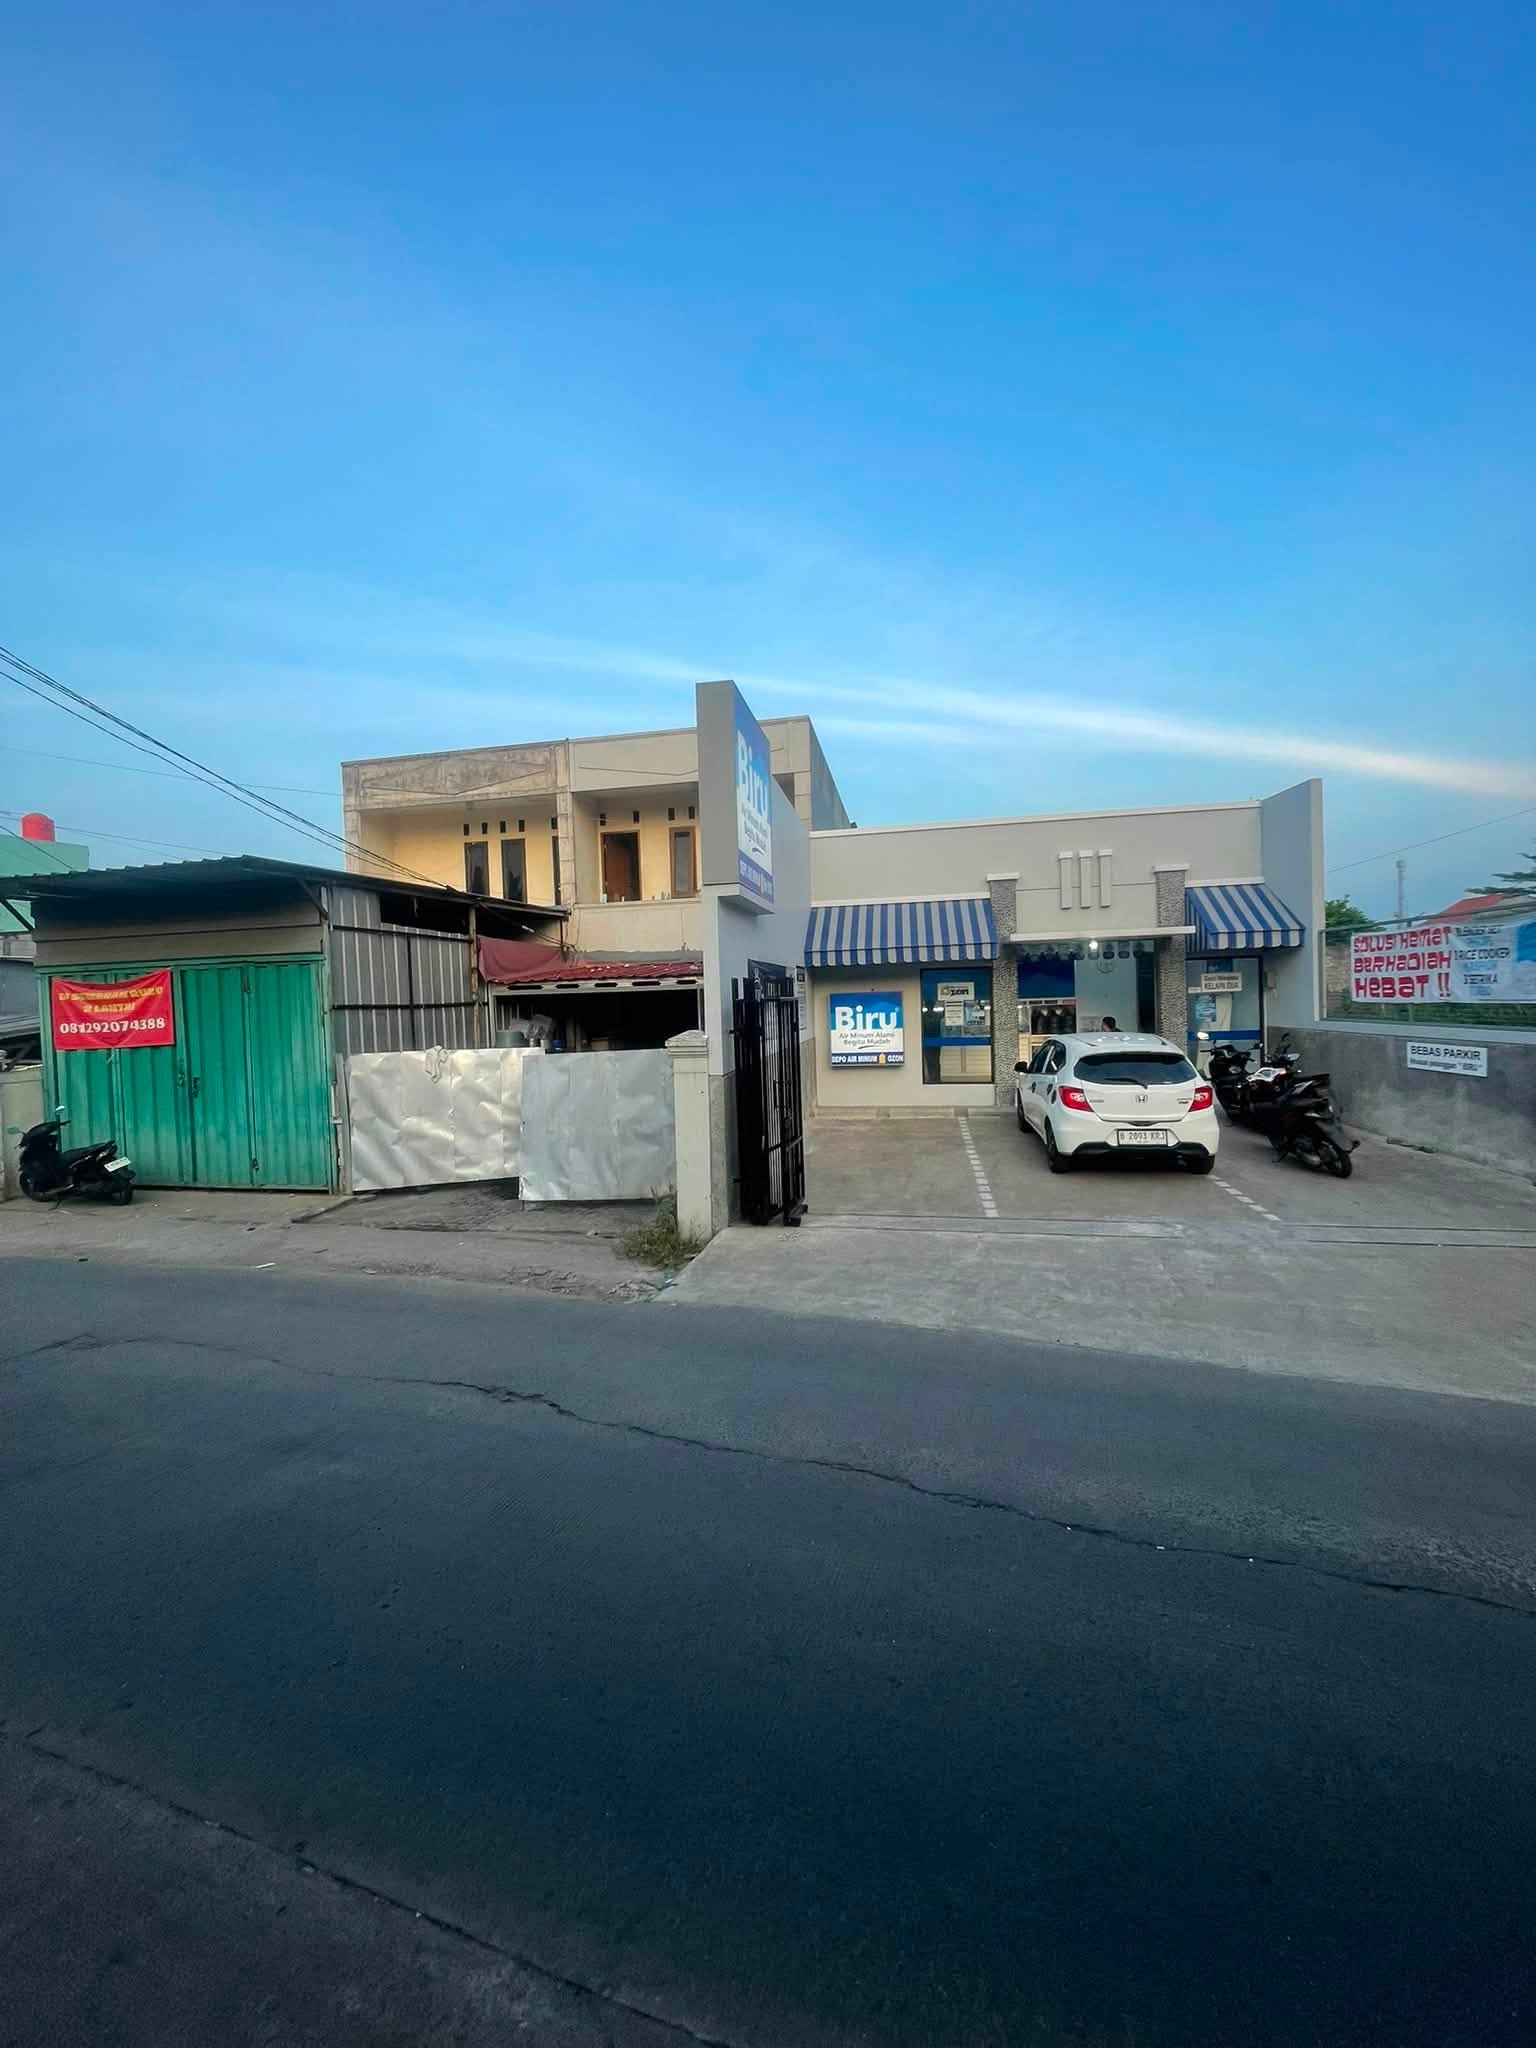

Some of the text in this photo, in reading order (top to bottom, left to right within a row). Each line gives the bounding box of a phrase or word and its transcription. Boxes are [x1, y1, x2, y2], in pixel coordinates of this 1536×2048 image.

[737, 729, 768, 816] Biru
[835, 1004, 897, 1031] Biru
[1411, 1045, 1481, 1061] BEBAS PARKIR
